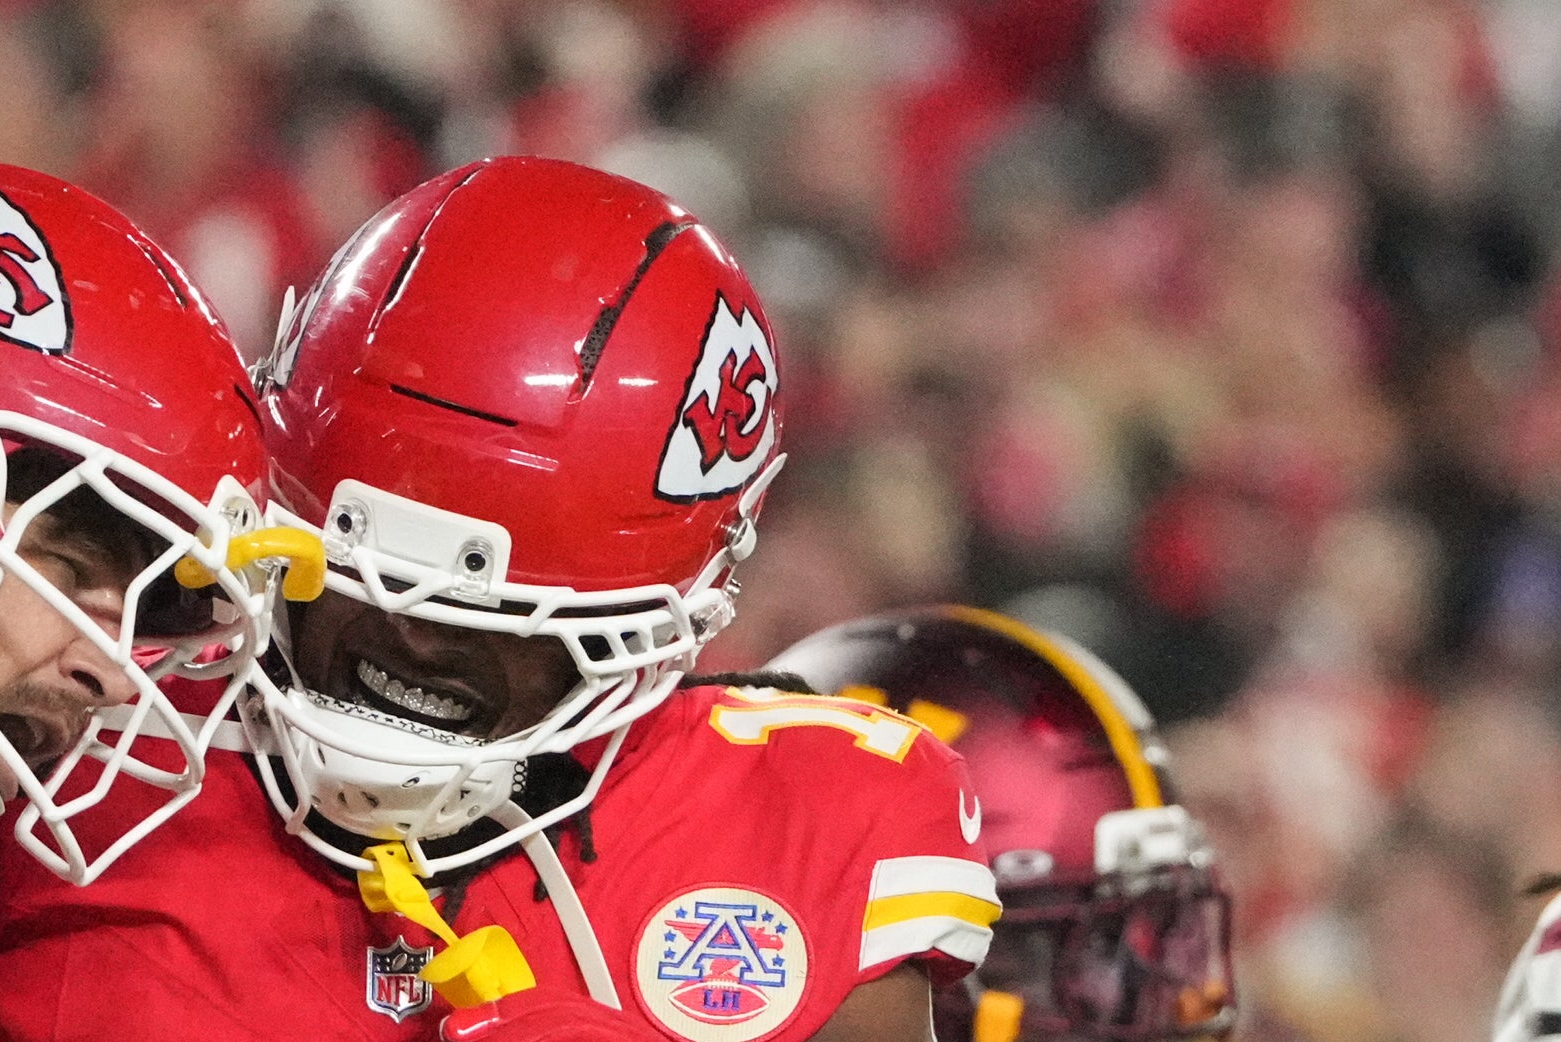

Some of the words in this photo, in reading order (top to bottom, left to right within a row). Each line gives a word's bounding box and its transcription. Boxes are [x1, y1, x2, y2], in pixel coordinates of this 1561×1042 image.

[657, 901, 786, 988] A
[376, 974, 422, 1007] NFL
[702, 988, 742, 1011] LH
